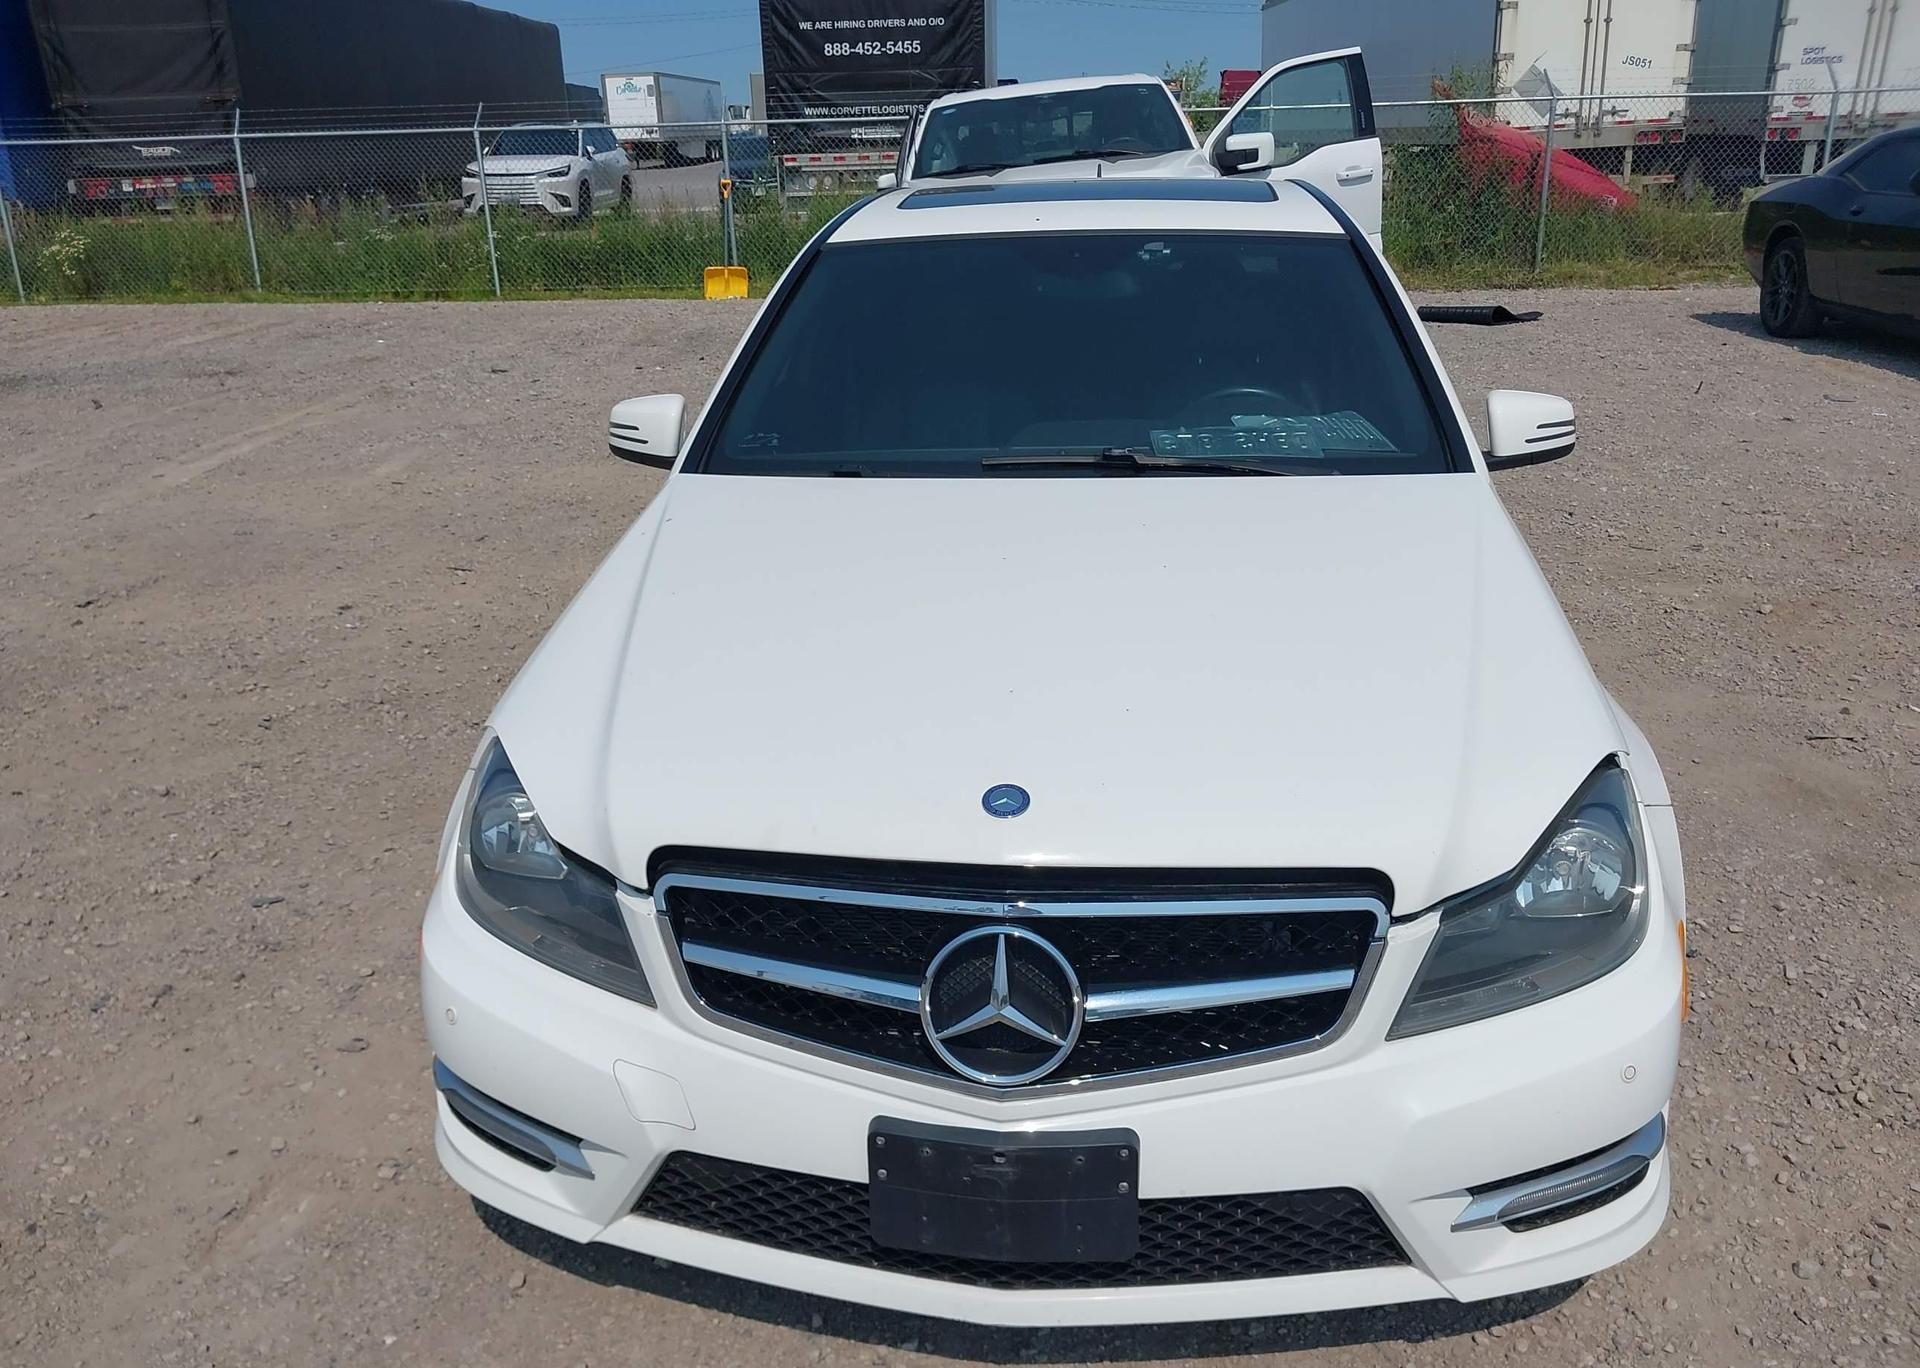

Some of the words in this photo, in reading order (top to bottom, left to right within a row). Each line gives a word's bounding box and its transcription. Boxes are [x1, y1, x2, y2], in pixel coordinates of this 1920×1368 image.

[799, 21, 813, 30] WE
[815, 21, 833, 29] ARE
[835, 20, 866, 29] HIRING
[867, 18, 906, 28] DRIVERS
[908, 17, 927, 26] AND
[824, 40, 921, 56] 888-452-5455
[1802, 46, 1826, 56] SPOT
[1621, 55, 1653, 69] JS051
[1800, 55, 1843, 65] LOGISTICS
